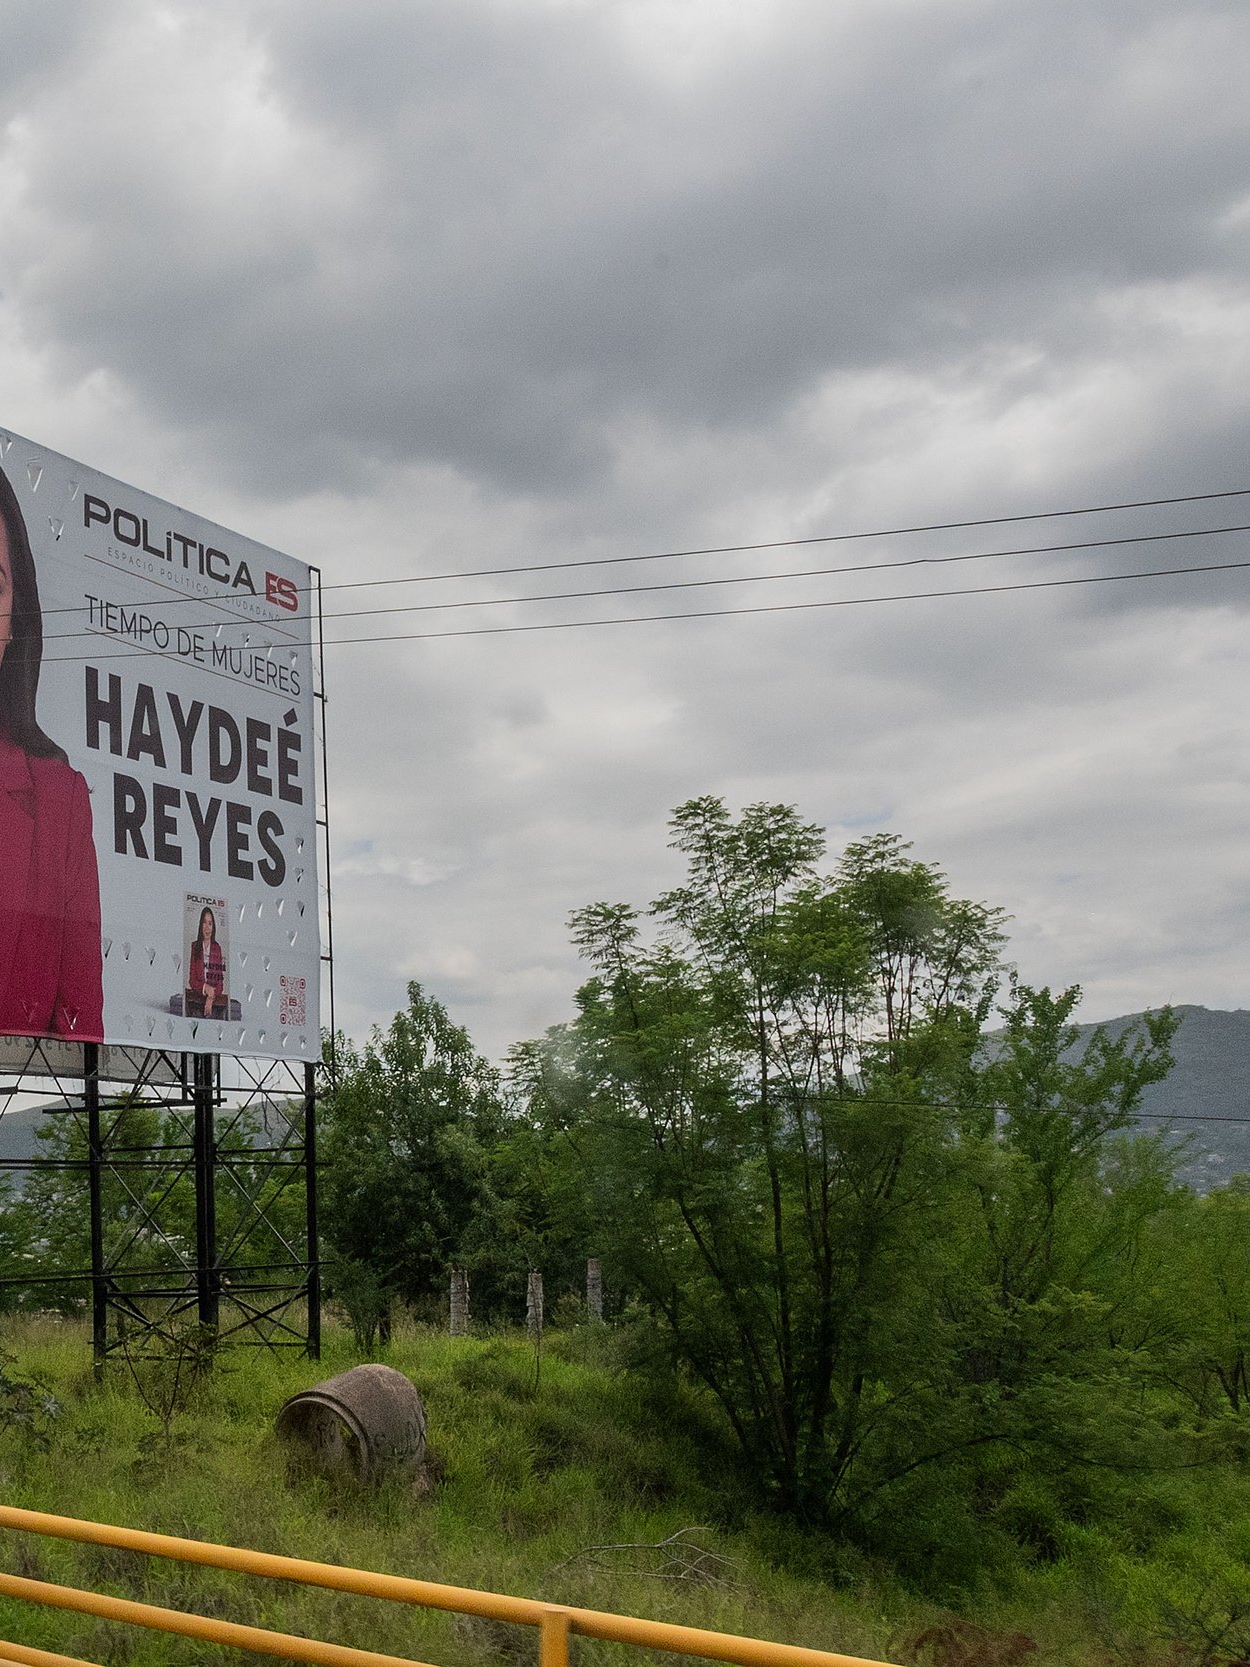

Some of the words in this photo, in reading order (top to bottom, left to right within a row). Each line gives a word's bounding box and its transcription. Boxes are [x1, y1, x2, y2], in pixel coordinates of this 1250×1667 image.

[107, 546, 154, 574] ESPACIO
[225, 593, 280, 622] CIUDADANO
[265, 571, 299, 613] ES
[85, 594, 169, 649] TIEMPO
[177, 628, 205, 662] DE
[212, 641, 301, 696] MUJERES
[85, 665, 303, 806] HAYDEÉ
[113, 772, 286, 887] REYES
